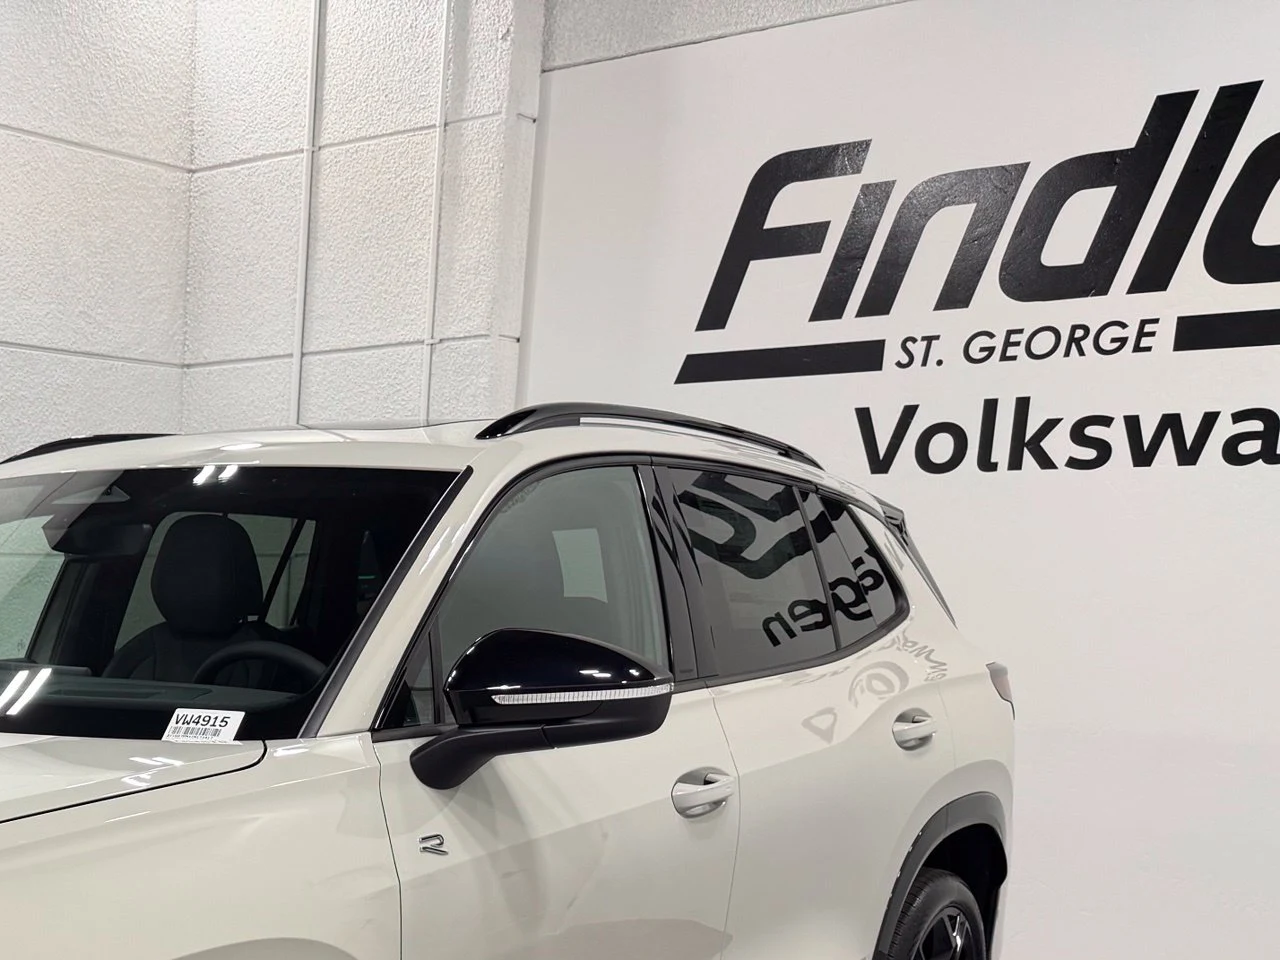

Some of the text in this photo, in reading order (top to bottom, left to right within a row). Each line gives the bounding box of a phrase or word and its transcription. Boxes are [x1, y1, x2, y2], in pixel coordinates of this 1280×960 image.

[895, 317, 1161, 370] ST. GEORGE
[854, 396, 1280, 476] Volkswa
[174, 713, 231, 728] VW4915
[418, 833, 449, 856] R
